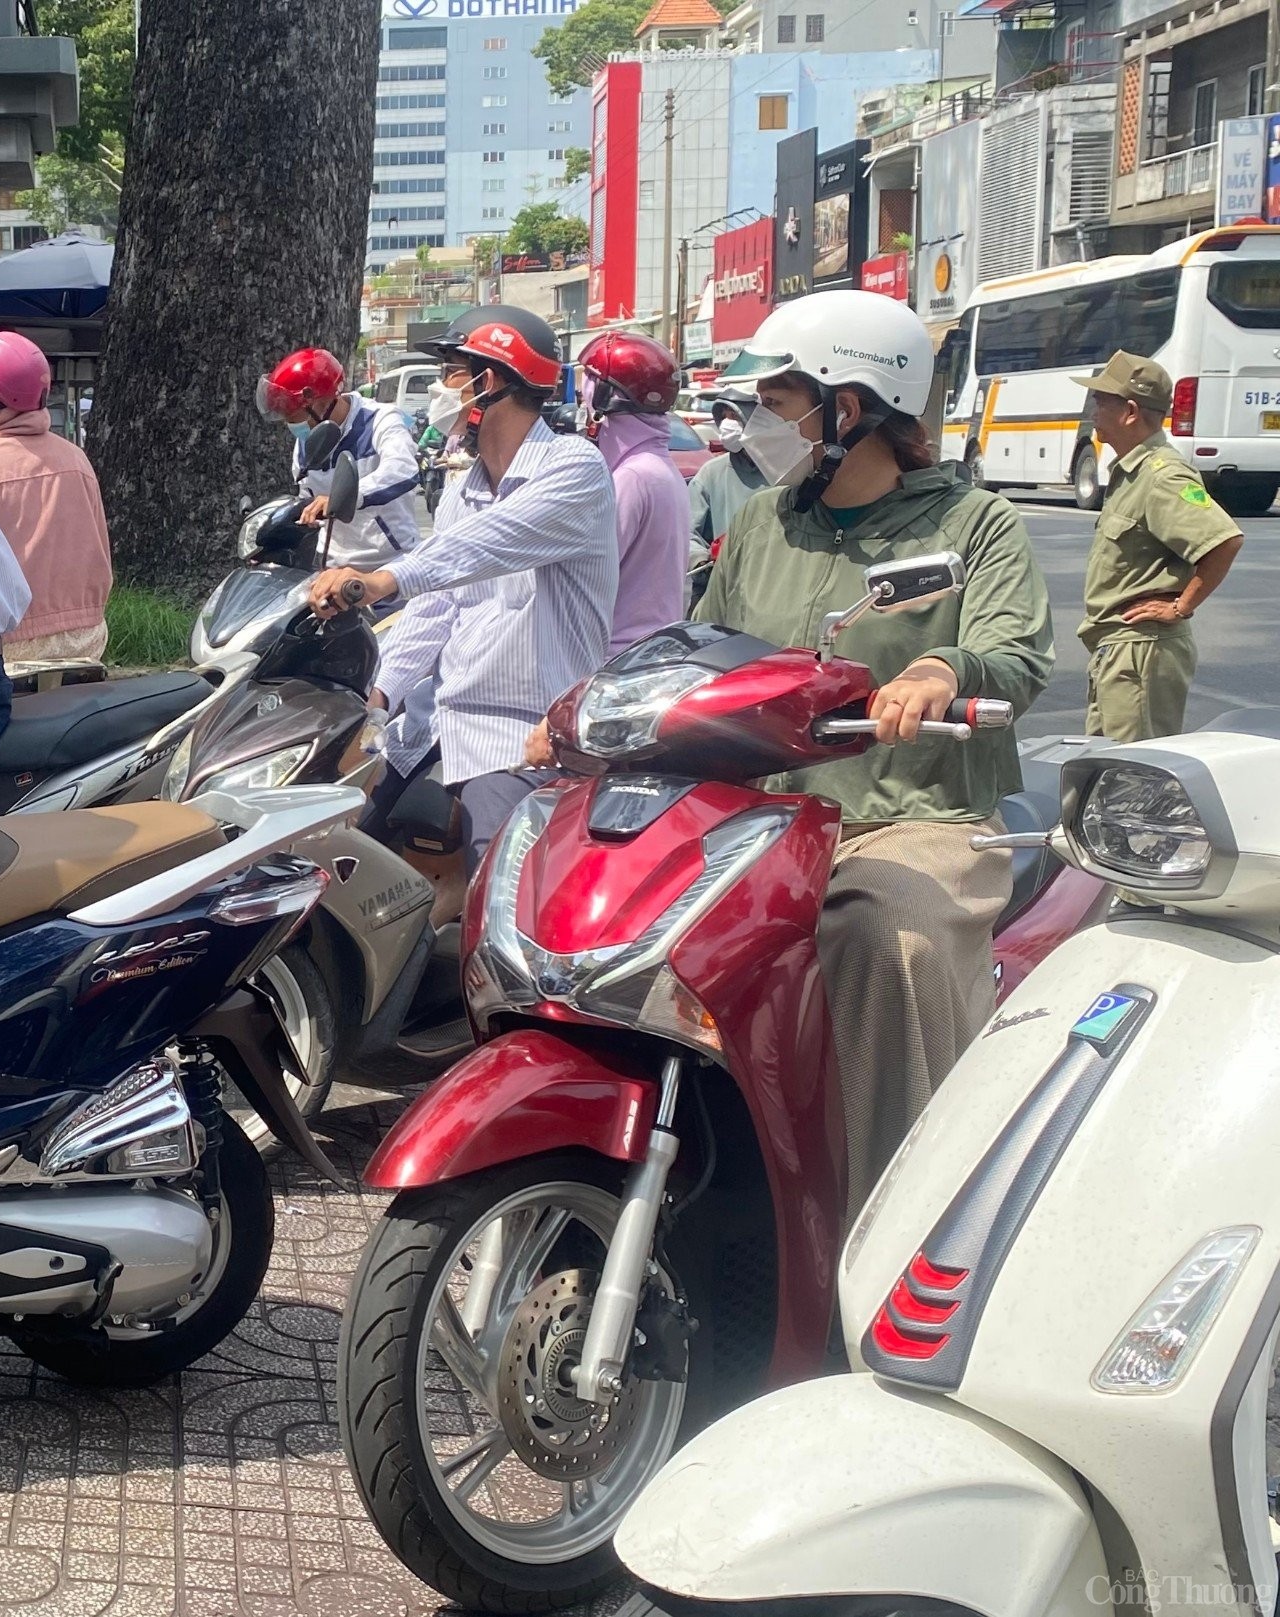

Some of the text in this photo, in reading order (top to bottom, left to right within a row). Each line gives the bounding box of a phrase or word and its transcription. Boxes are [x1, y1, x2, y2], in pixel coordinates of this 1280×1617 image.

[1227, 194, 1256, 210] BAY
[832, 344, 896, 368] Vietcombank
[609, 785, 660, 797] HONDA
[358, 878, 412, 917] YAMAHA
